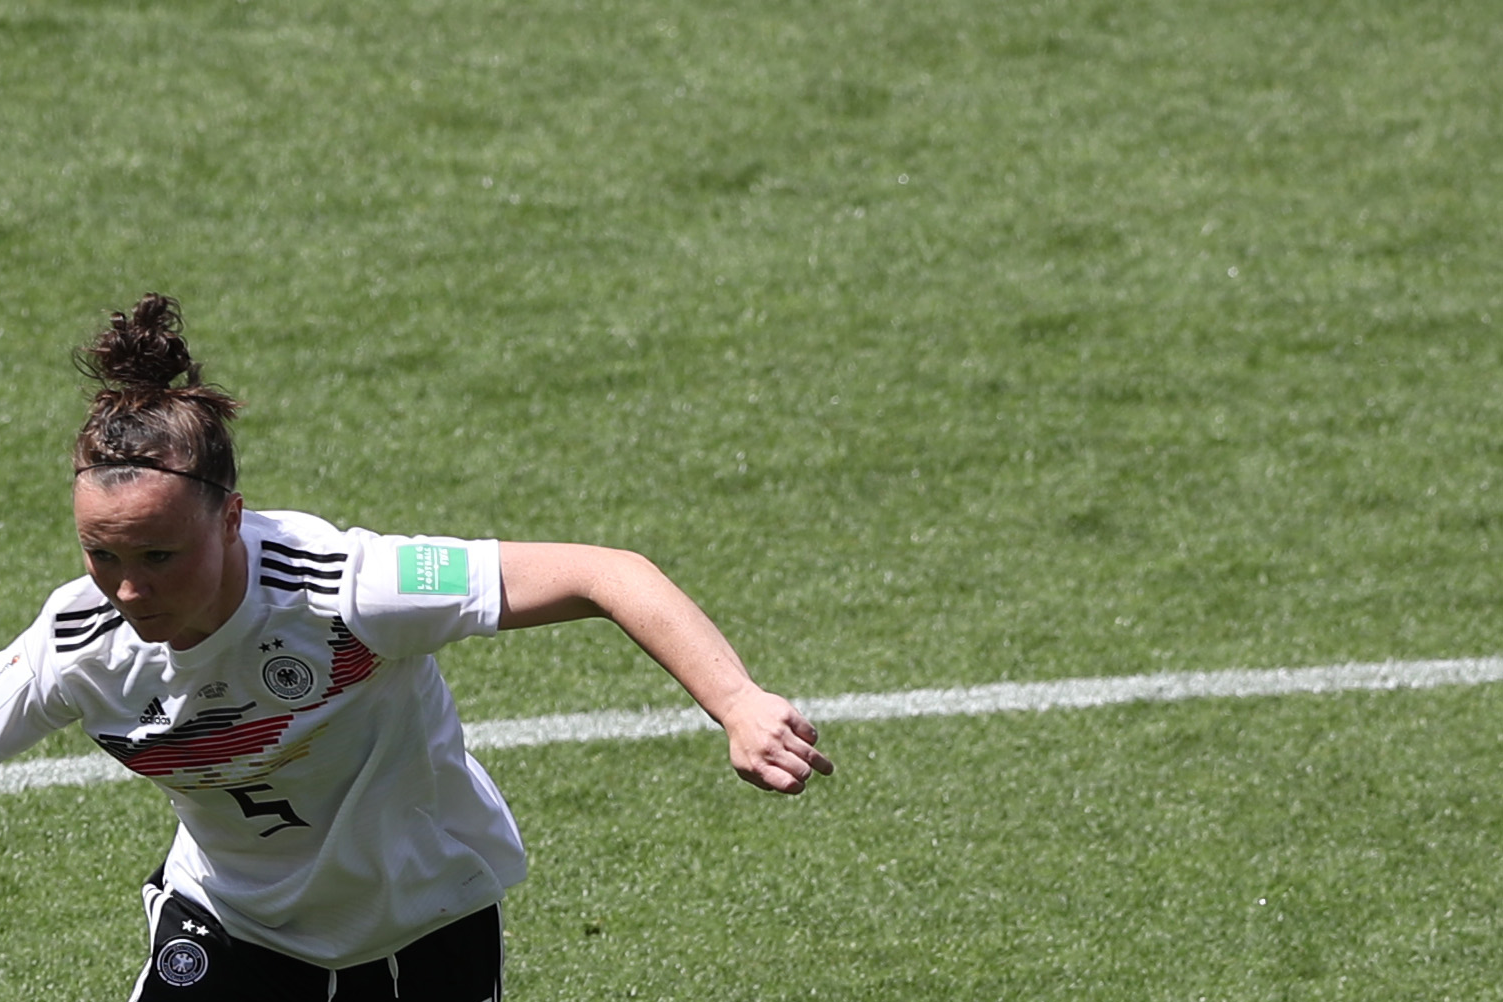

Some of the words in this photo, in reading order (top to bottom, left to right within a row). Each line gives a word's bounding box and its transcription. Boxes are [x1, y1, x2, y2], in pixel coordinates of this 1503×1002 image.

[415, 545, 425, 590] LIVING
[424, 546, 433, 590] FOOTBALL
[139, 714, 171, 726] adidas
[224, 783, 311, 838] 5
